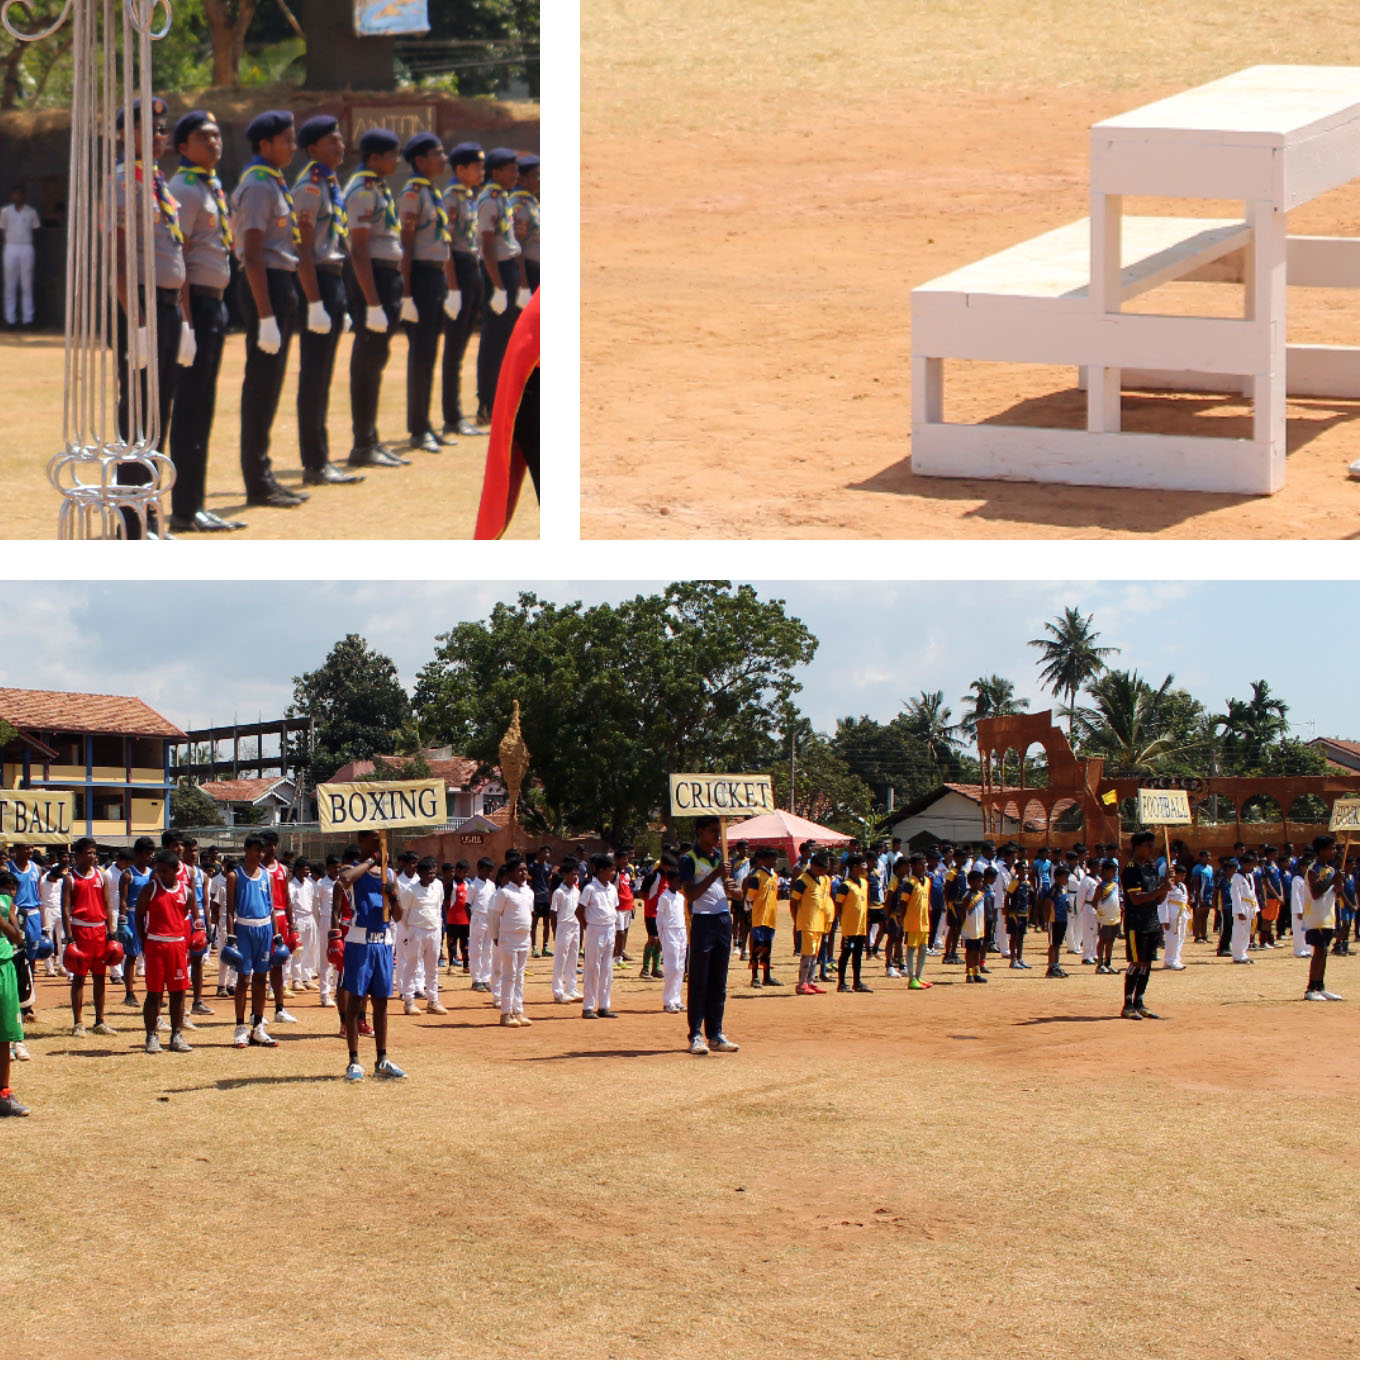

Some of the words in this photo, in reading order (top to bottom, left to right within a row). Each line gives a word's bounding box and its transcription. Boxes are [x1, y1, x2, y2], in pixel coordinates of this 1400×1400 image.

[328, 788, 438, 824] BOXING
[675, 781, 769, 809] CRICKET
[1142, 796, 1189, 818] FOOTBALL
[14, 800, 70, 834] BALL
